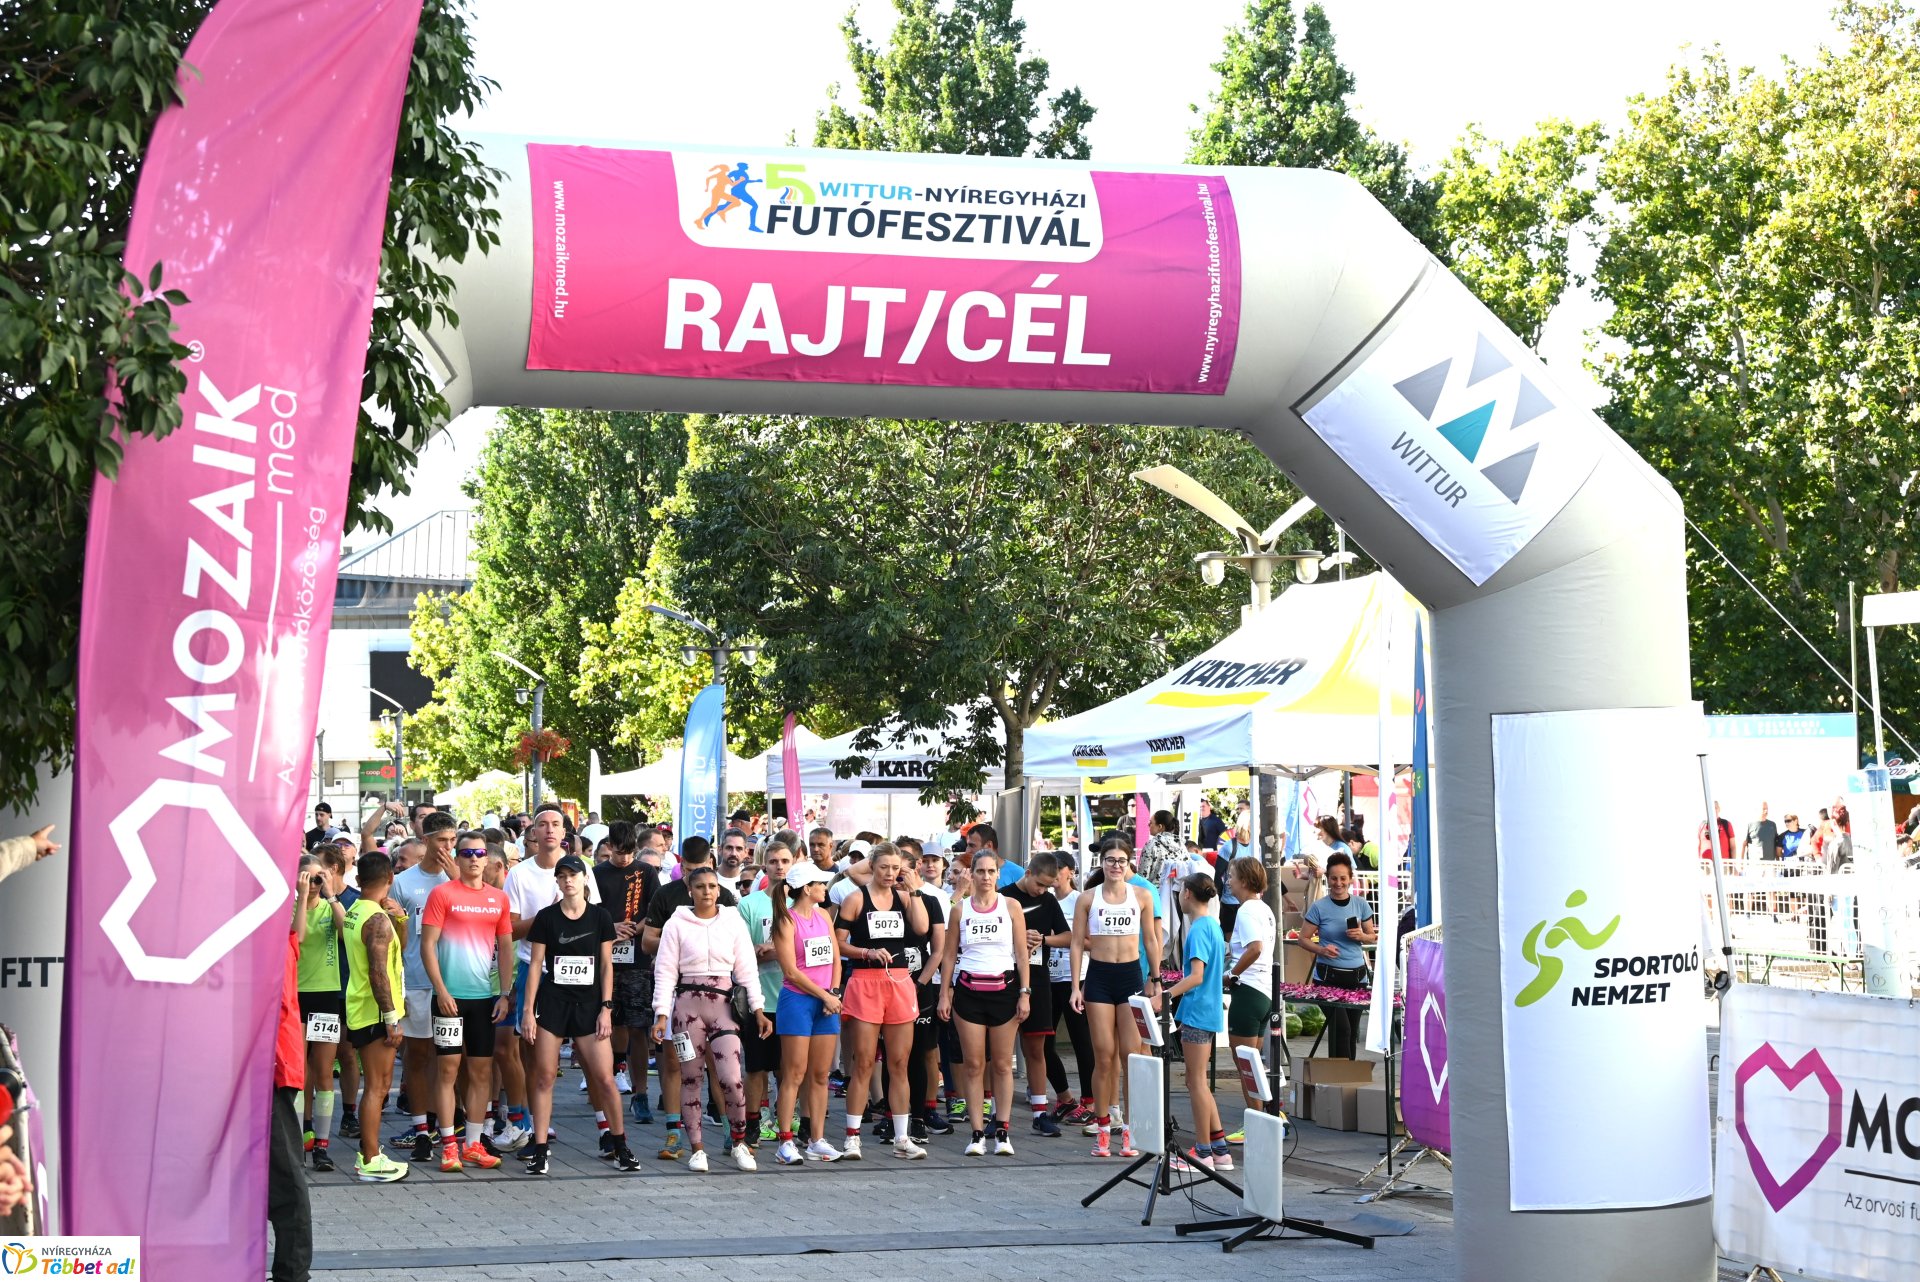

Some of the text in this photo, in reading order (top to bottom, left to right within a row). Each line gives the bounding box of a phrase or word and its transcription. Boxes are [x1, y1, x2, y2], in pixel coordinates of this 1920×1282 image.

[819, 182, 1086, 208] WITTUR-NYÍREGYHÁZI
[766, 201, 1091, 248] FUTÓFESZTIVÁL
[553, 180, 570, 319] www.mozaikmed.hu
[1197, 183, 1223, 384] www.nyiregyhazifutofesztival.hu
[664, 274, 1112, 366] RAJT/CÉL
[264, 385, 298, 495] med
[1391, 431, 1468, 508] WITTUR
[158, 370, 261, 777] MOZAIK
[1171, 657, 1308, 690] KÄRCHER
[1072, 744, 1107, 757] KÄRCHER
[1146, 735, 1186, 752] KÄRCHER
[878, 760, 938, 778] KÄRC
[451, 905, 501, 914] HUNGARY
[1105, 916, 1131, 926] 5100
[875, 919, 899, 929] 5073
[971, 924, 998, 935] 5150
[612, 946, 629, 955] 043
[1594, 944, 1699, 979] SPORTOLÓ
[560, 965, 588, 975] 5104
[1571, 982, 1671, 1007] NEMZET
[313, 1022, 338, 1034] 5148
[435, 1026, 459, 1037] 5018
[1844, 1192, 1862, 1210] Az
[1865, 1198, 1905, 1218] orvosi
